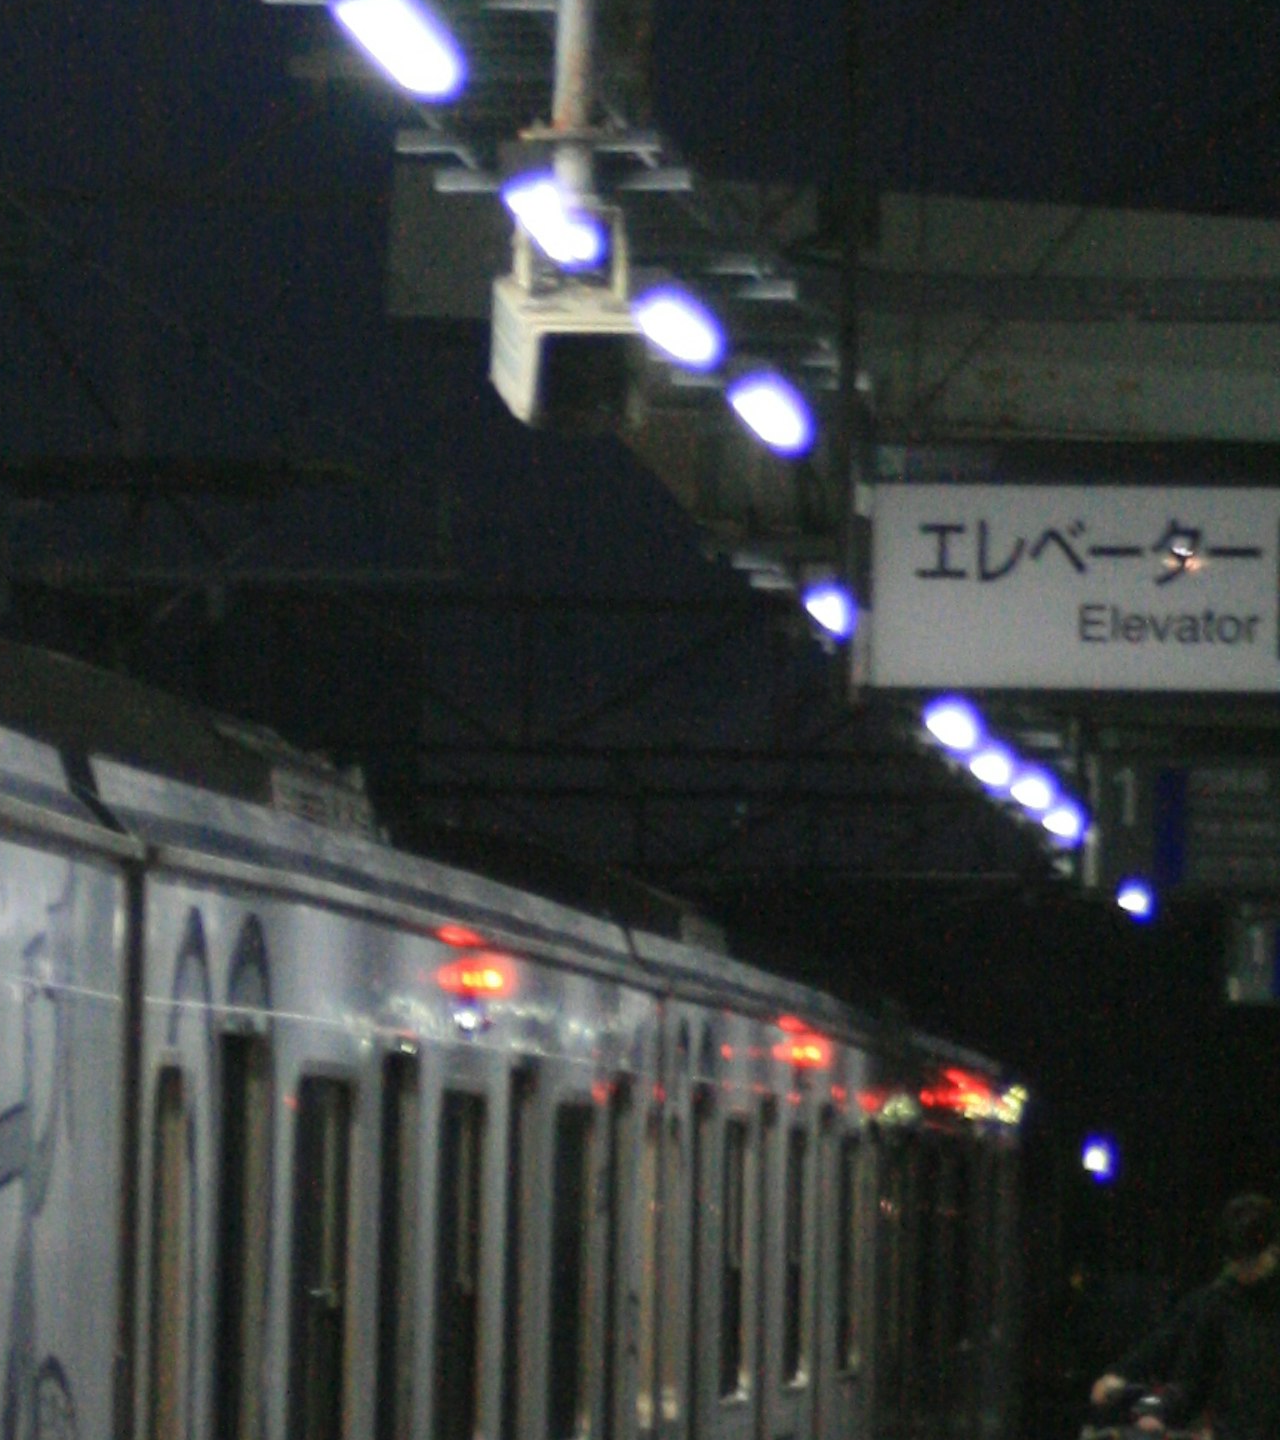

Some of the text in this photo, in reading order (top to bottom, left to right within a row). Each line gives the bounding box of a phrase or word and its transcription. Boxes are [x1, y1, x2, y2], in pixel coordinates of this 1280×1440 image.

[915, 518, 1263, 587] エレベーター
[1077, 602, 1261, 644] Elevator
